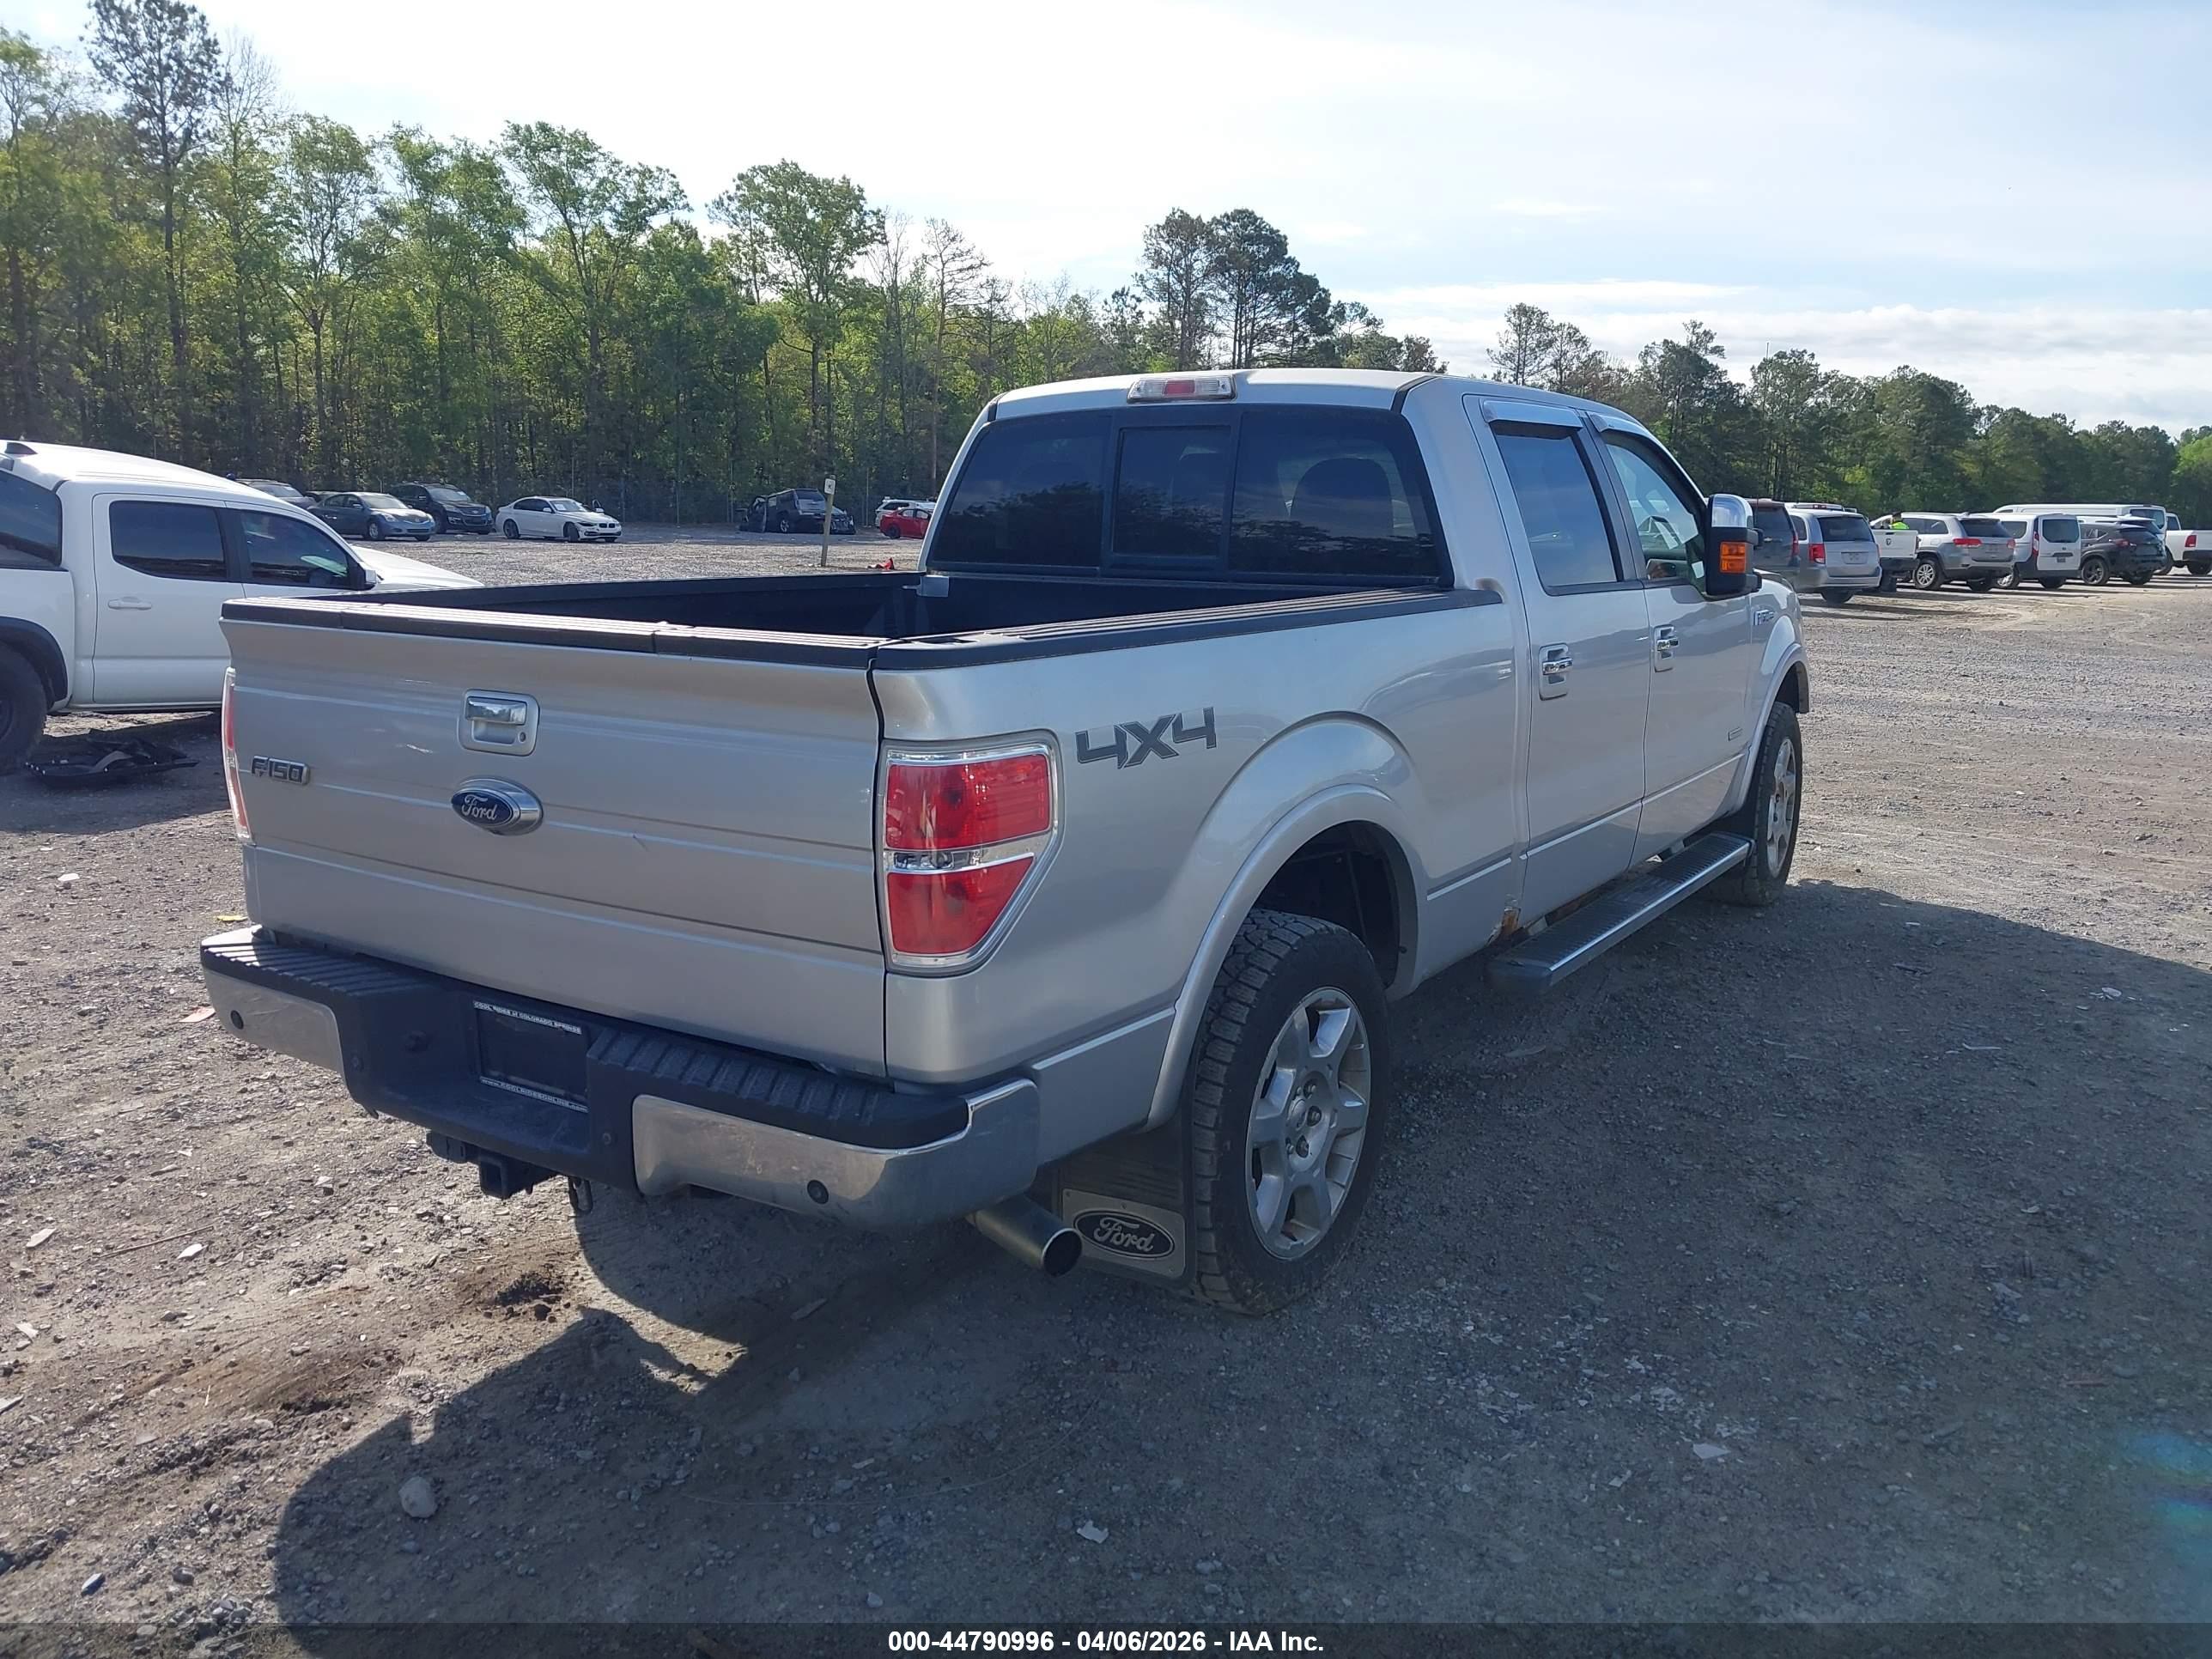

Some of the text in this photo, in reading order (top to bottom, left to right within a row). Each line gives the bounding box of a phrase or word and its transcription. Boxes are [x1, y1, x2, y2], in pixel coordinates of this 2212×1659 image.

[461, 793, 498, 821] Ford
[473, 1001, 493, 1012] COOL
[519, 1012, 552, 1030] COLORADO
[554, 1021, 582, 1034] SPRINGS
[1093, 1217, 1156, 1252] Ford
